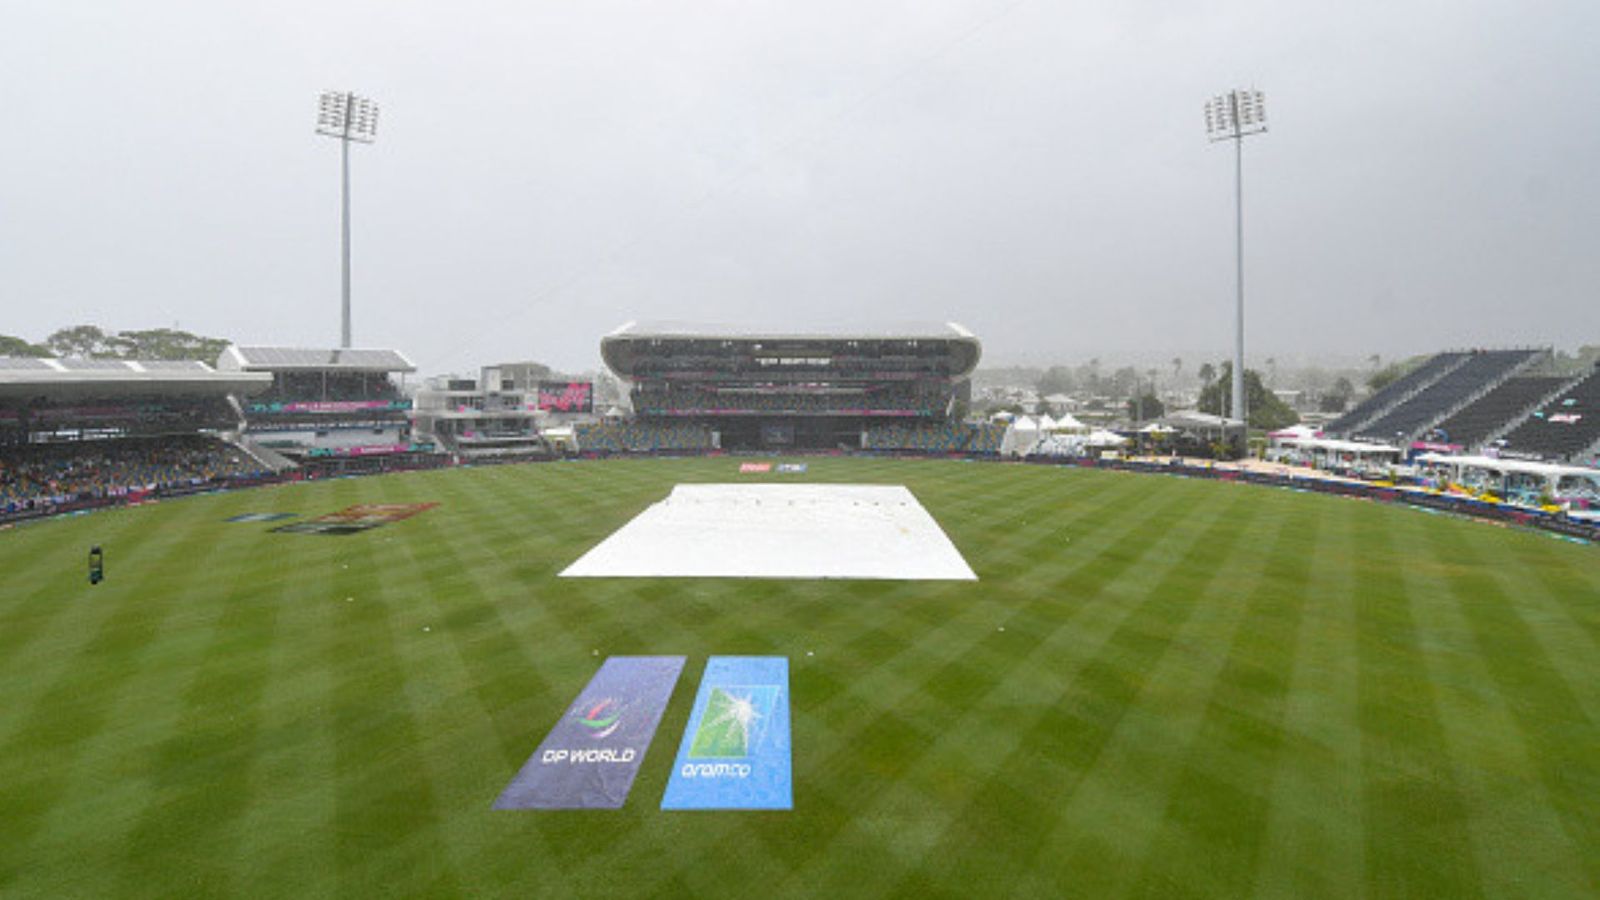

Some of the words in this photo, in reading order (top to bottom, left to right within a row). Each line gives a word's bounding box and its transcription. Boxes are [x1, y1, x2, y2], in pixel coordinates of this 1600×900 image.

[543, 749, 569, 762] DP
[571, 748, 635, 762] WORLD
[682, 763, 750, 777] aramco
